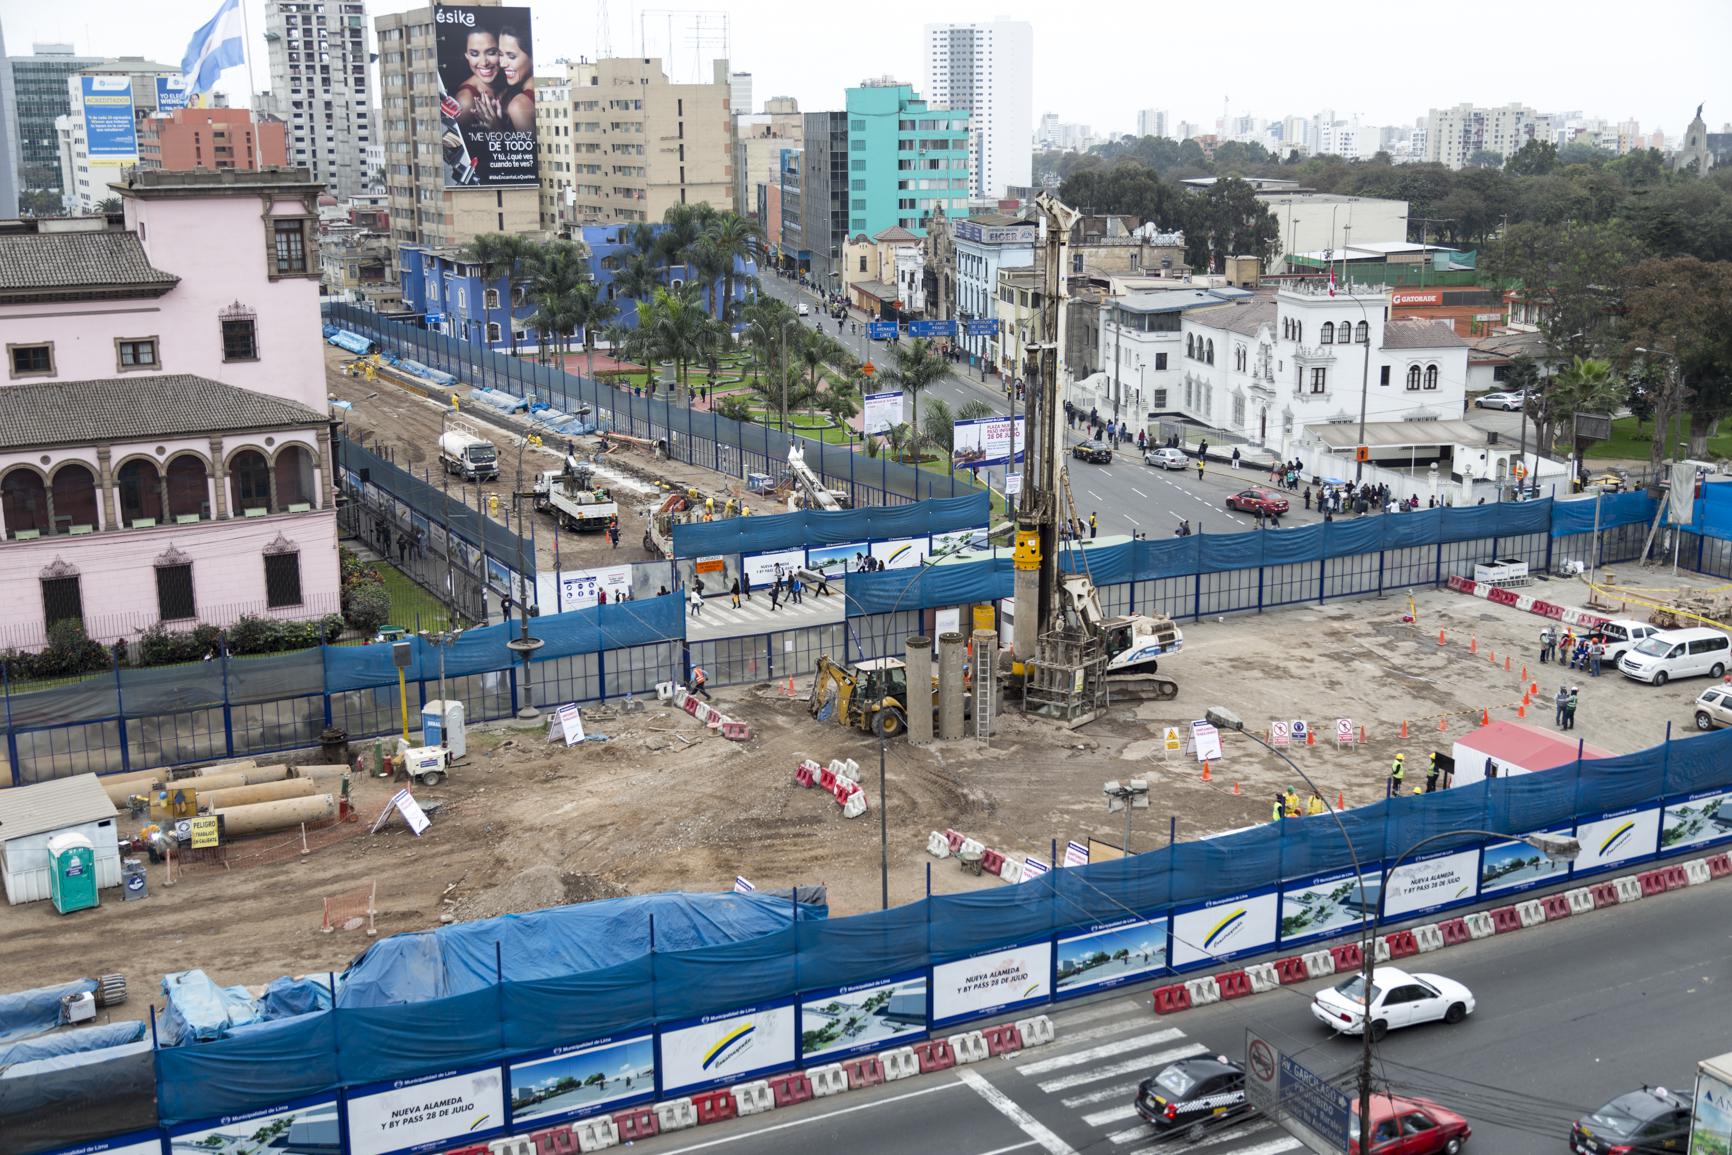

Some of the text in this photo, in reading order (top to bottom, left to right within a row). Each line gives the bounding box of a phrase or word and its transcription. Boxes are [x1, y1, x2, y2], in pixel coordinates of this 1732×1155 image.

[436, 9, 476, 27] ésika
[485, 132, 503, 140] VEO
[504, 131, 532, 140] CAPAZ
[489, 142, 502, 151] DE
[194, 820, 216, 829] PELIGRO
[1410, 871, 1454, 885] NUEVA ALAMEDA
[1446, 877, 1461, 885] JULIO
[966, 966, 1020, 983] NUEVA ALAMEDA
[848, 981, 875, 992] Municipalidad
[973, 982, 989, 990] PASS
[1010, 973, 1028, 982] JULIO
[710, 1010, 739, 1021] Municipalidad
[562, 1040, 593, 1052] Municipalidad
[404, 1073, 437, 1085] Municipalidad
[1294, 1066, 1336, 1102] GARCILASO
[391, 1096, 463, 1118] NUEVA ALAMEDA
[232, 1108, 268, 1122] Municipalidad
[389, 1119, 399, 1128] BY
[402, 1114, 424, 1125] PASS
[426, 1112, 437, 1120] 28
[439, 1109, 449, 1117] DE
[452, 1103, 474, 1115] JULIO
